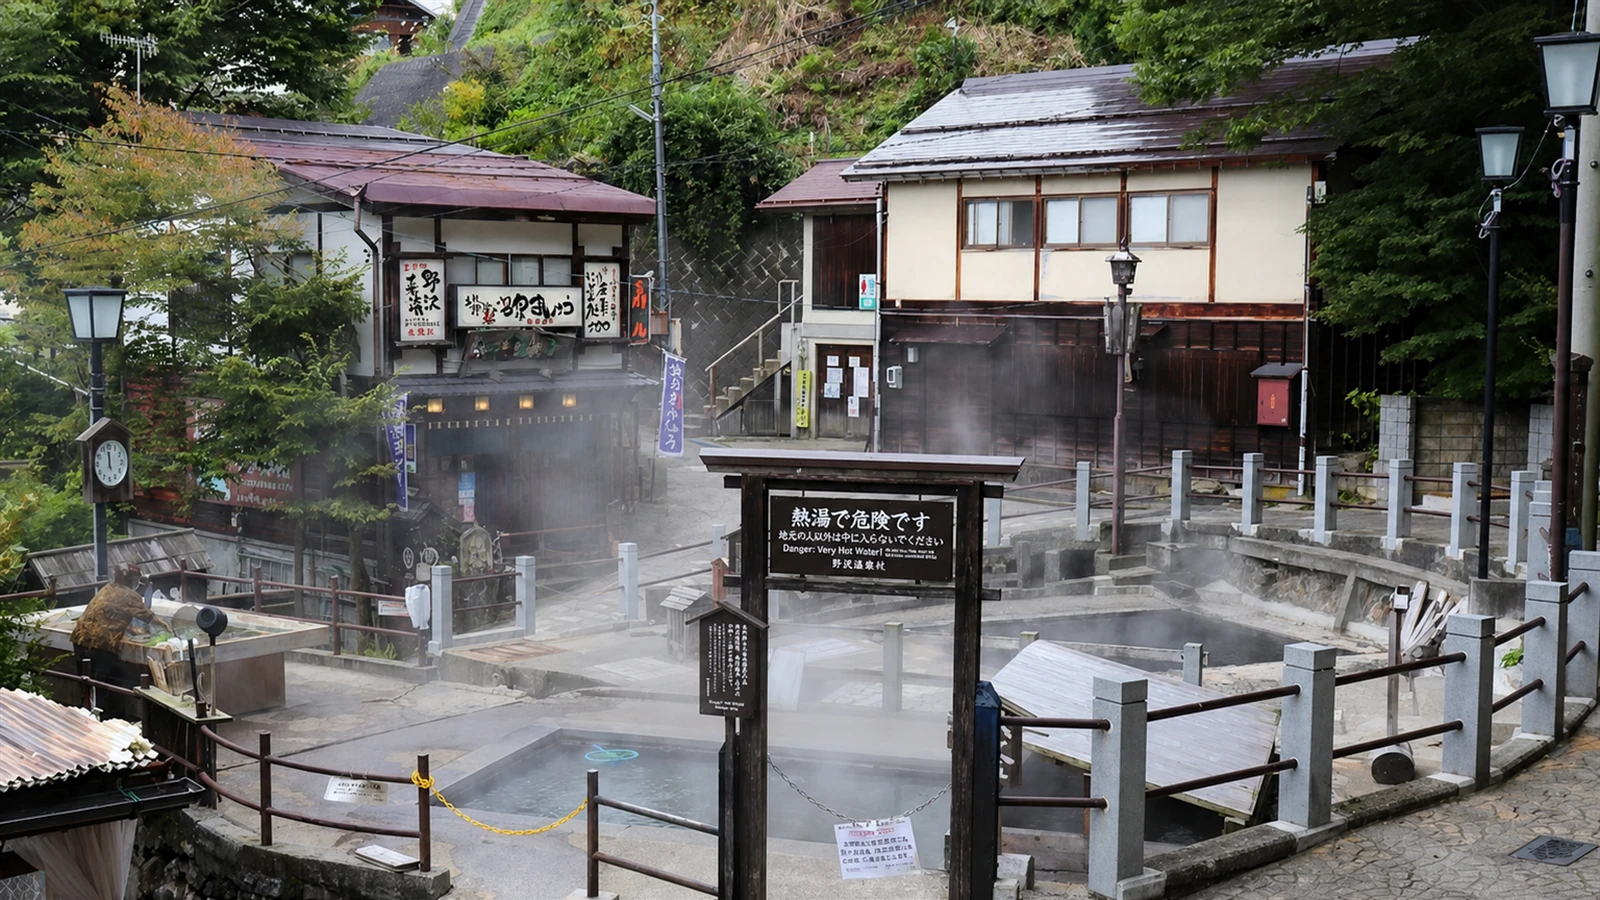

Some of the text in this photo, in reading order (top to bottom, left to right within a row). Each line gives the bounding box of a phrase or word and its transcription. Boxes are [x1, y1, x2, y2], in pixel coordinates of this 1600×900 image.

[791, 506, 931, 532] 熱湯で危険です
[778, 530, 944, 546] 地元の人以外は中に入らないでください
[782, 543, 816, 555] Danger:
[817, 545, 837, 556] Very
[838, 546, 853, 555] Hot
